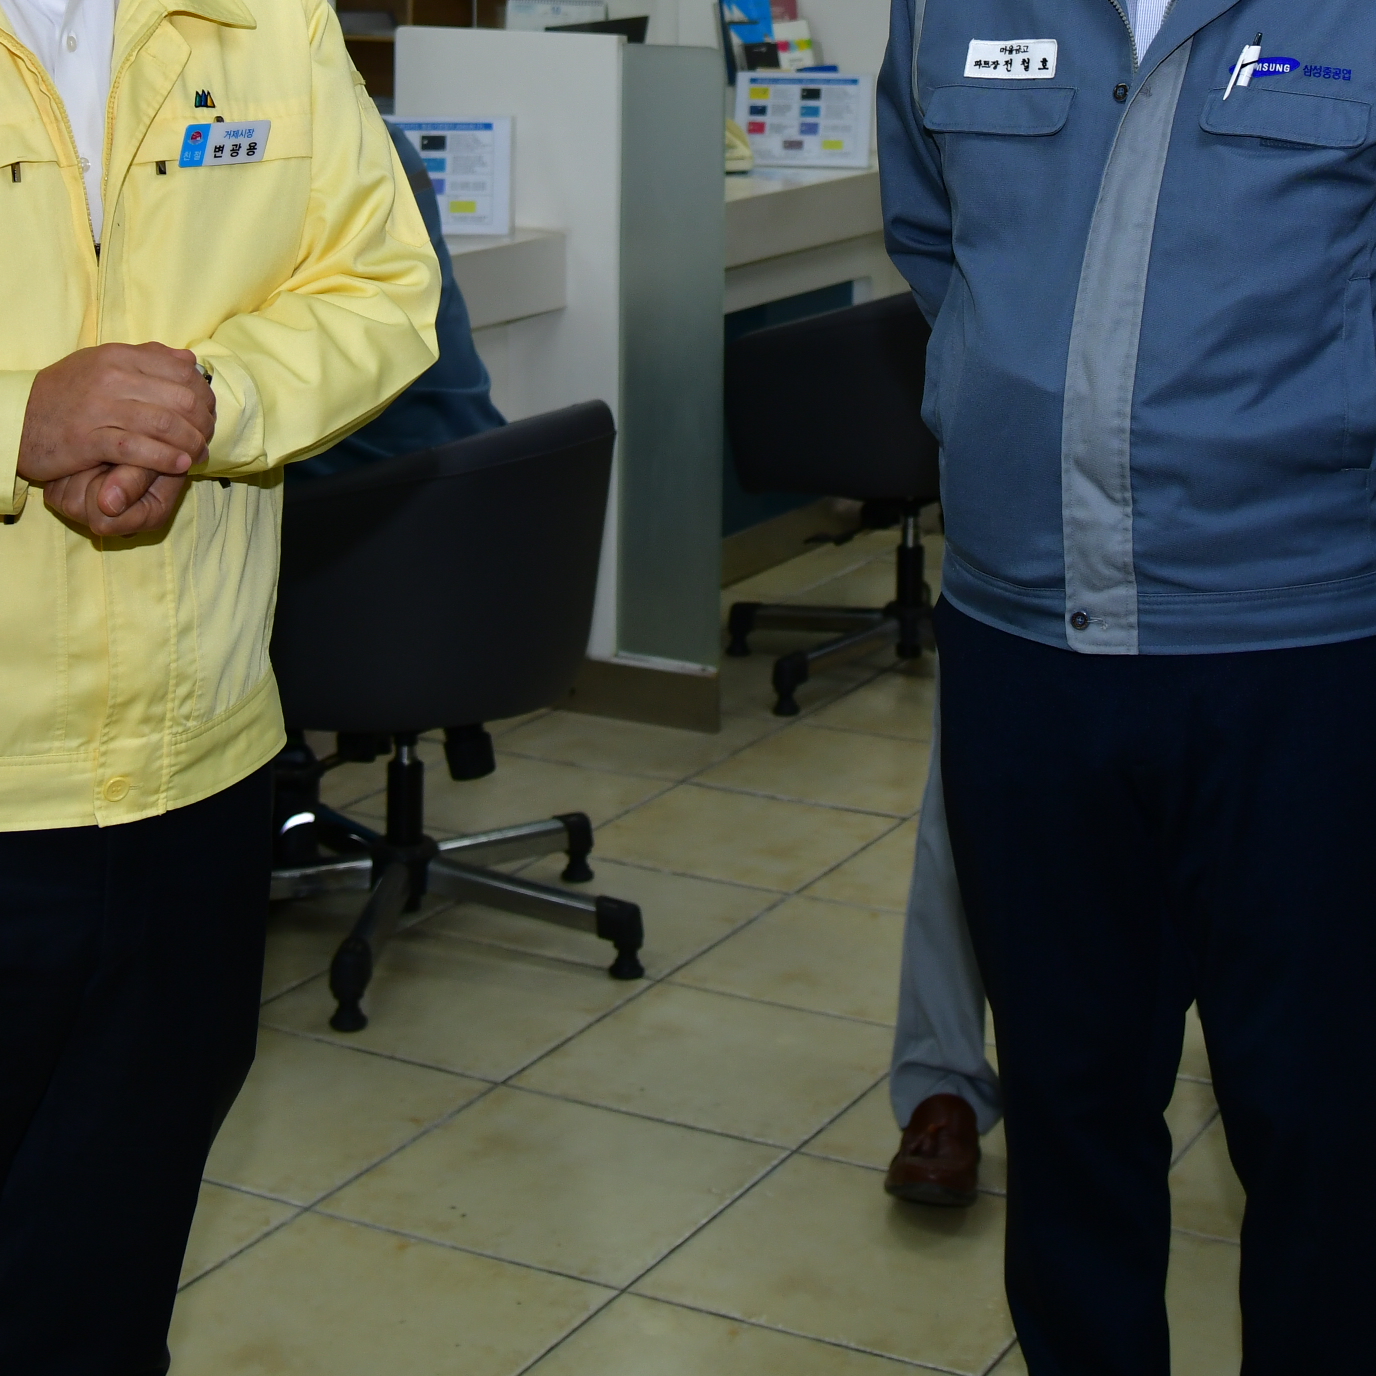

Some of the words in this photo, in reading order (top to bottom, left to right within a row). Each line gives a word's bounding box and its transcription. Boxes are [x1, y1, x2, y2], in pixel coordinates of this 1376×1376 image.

[999, 45, 1029, 55] 마을금고
[973, 59, 1000, 70] 파트장
[1256, 62, 1291, 73] MSUNG
[1303, 64, 1352, 81] 삼성중공업
[223, 128, 255, 140] 거제시장
